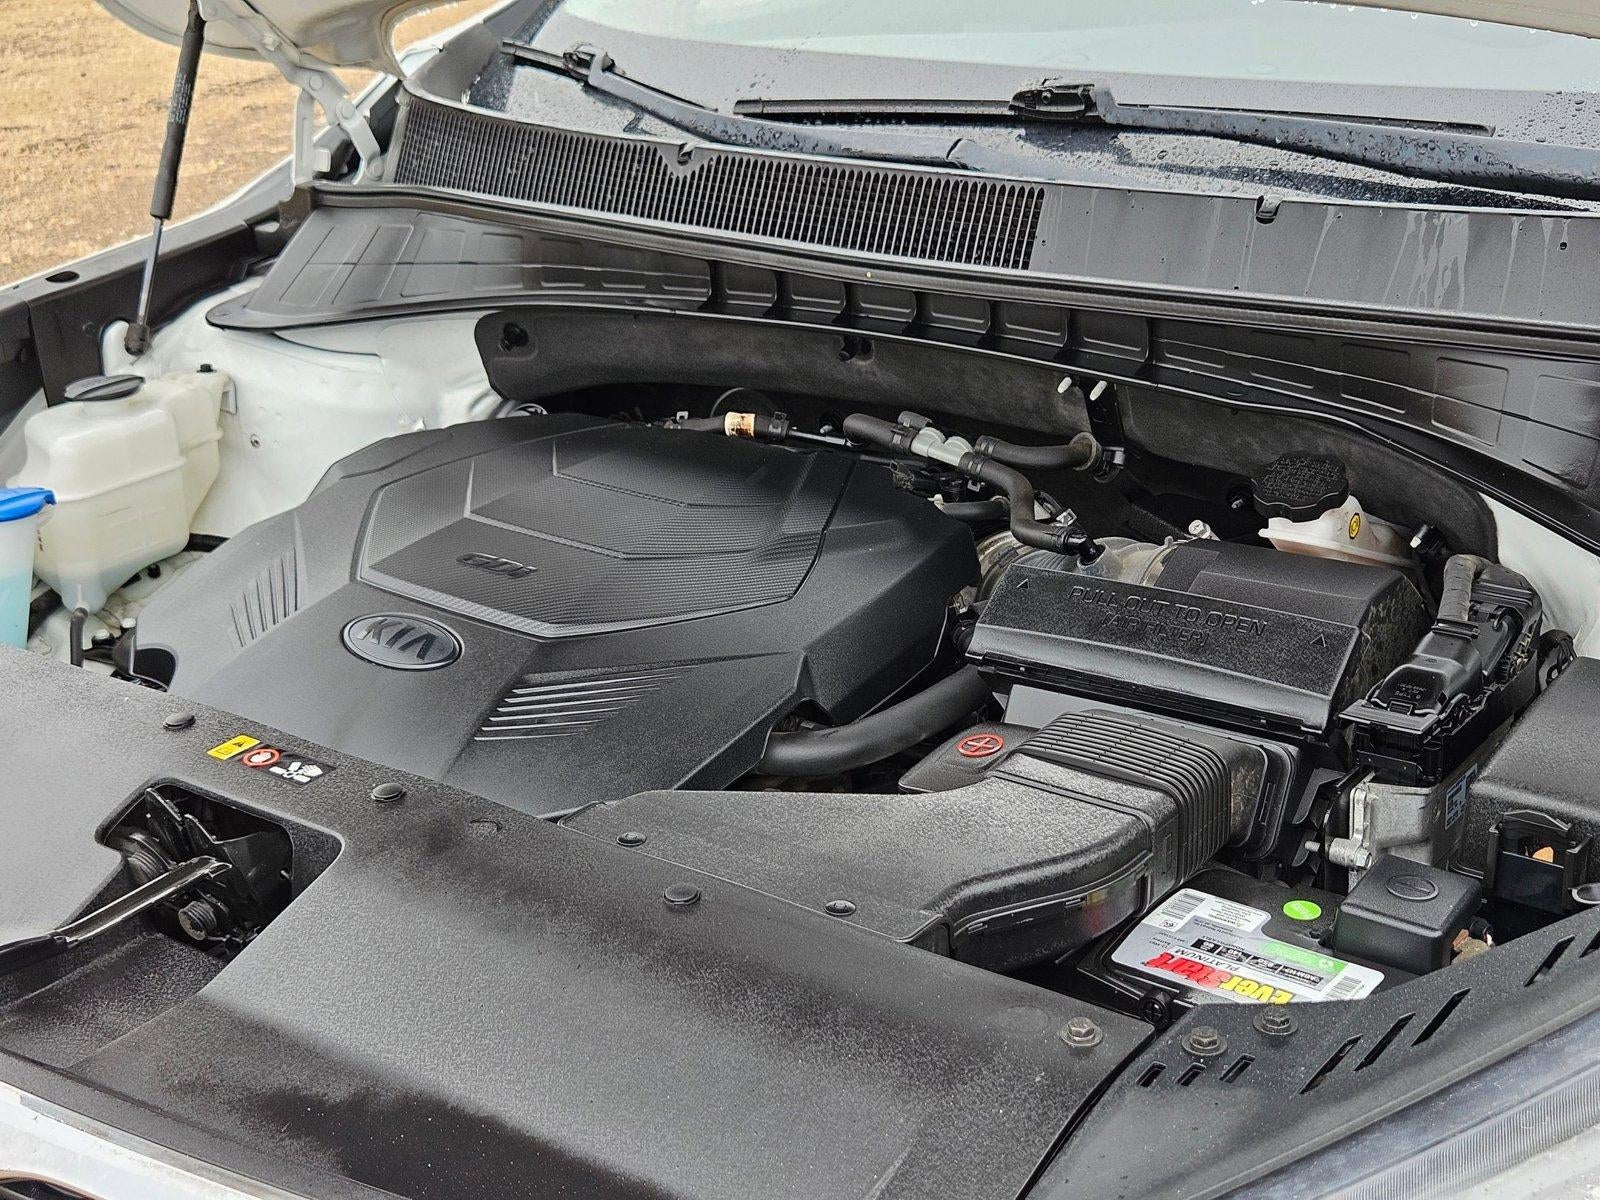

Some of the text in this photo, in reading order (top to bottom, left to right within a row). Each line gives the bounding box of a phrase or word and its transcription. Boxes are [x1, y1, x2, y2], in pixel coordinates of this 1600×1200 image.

[1068, 585, 1269, 637] PULL OUT TO OPEN
[357, 617, 438, 660] KIA
[1147, 952, 1294, 1005] EverStart
[1175, 947, 1241, 972] PLATINUM
